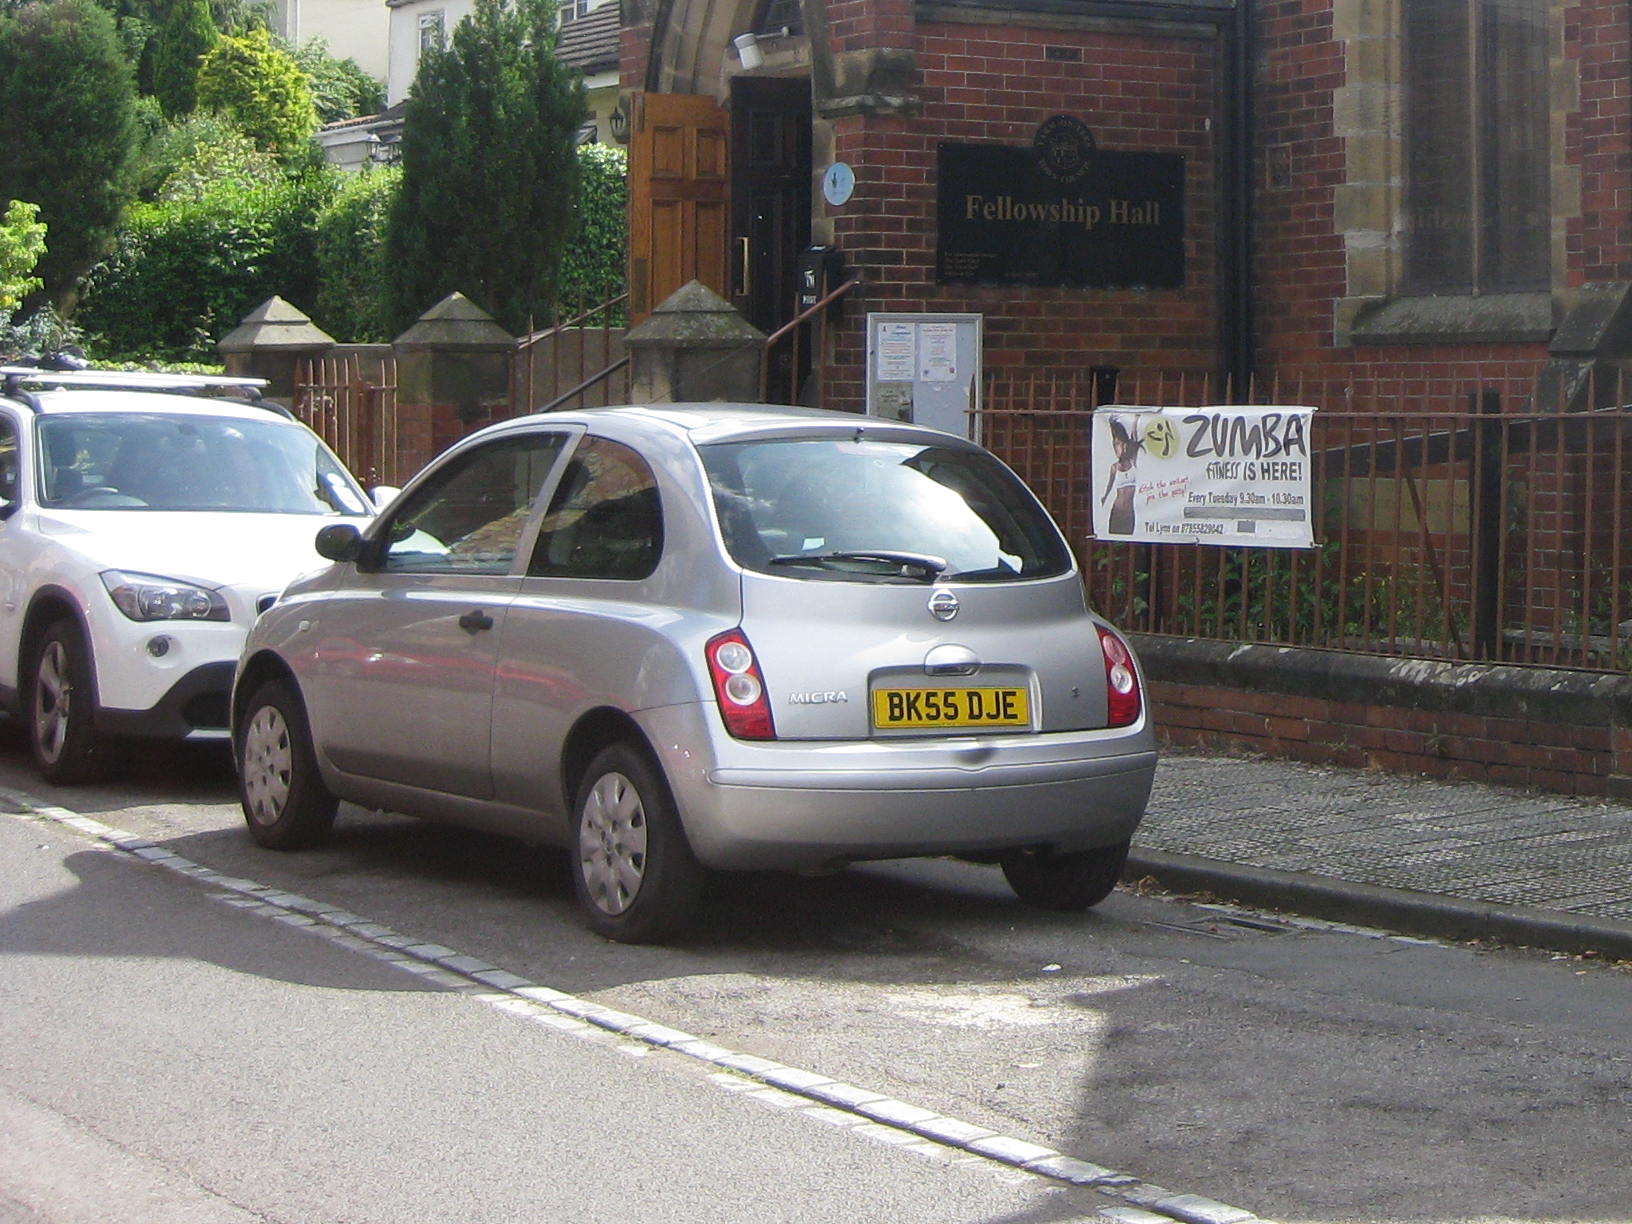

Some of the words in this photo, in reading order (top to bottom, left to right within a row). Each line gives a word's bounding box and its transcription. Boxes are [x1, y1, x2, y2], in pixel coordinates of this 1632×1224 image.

[966, 195, 1100, 230] Fellowship
[1109, 199, 1160, 225] Hall
[1182, 413, 1306, 460] ZUMBA
[1243, 462, 1256, 481] IS
[1260, 462, 1302, 481] HERE!
[1188, 492, 1206, 506] Every
[1208, 492, 1238, 506] Tuesday
[790, 689, 848, 705] MICRA
[887, 691, 960, 722] BK55
[966, 690, 1019, 721] DJE
